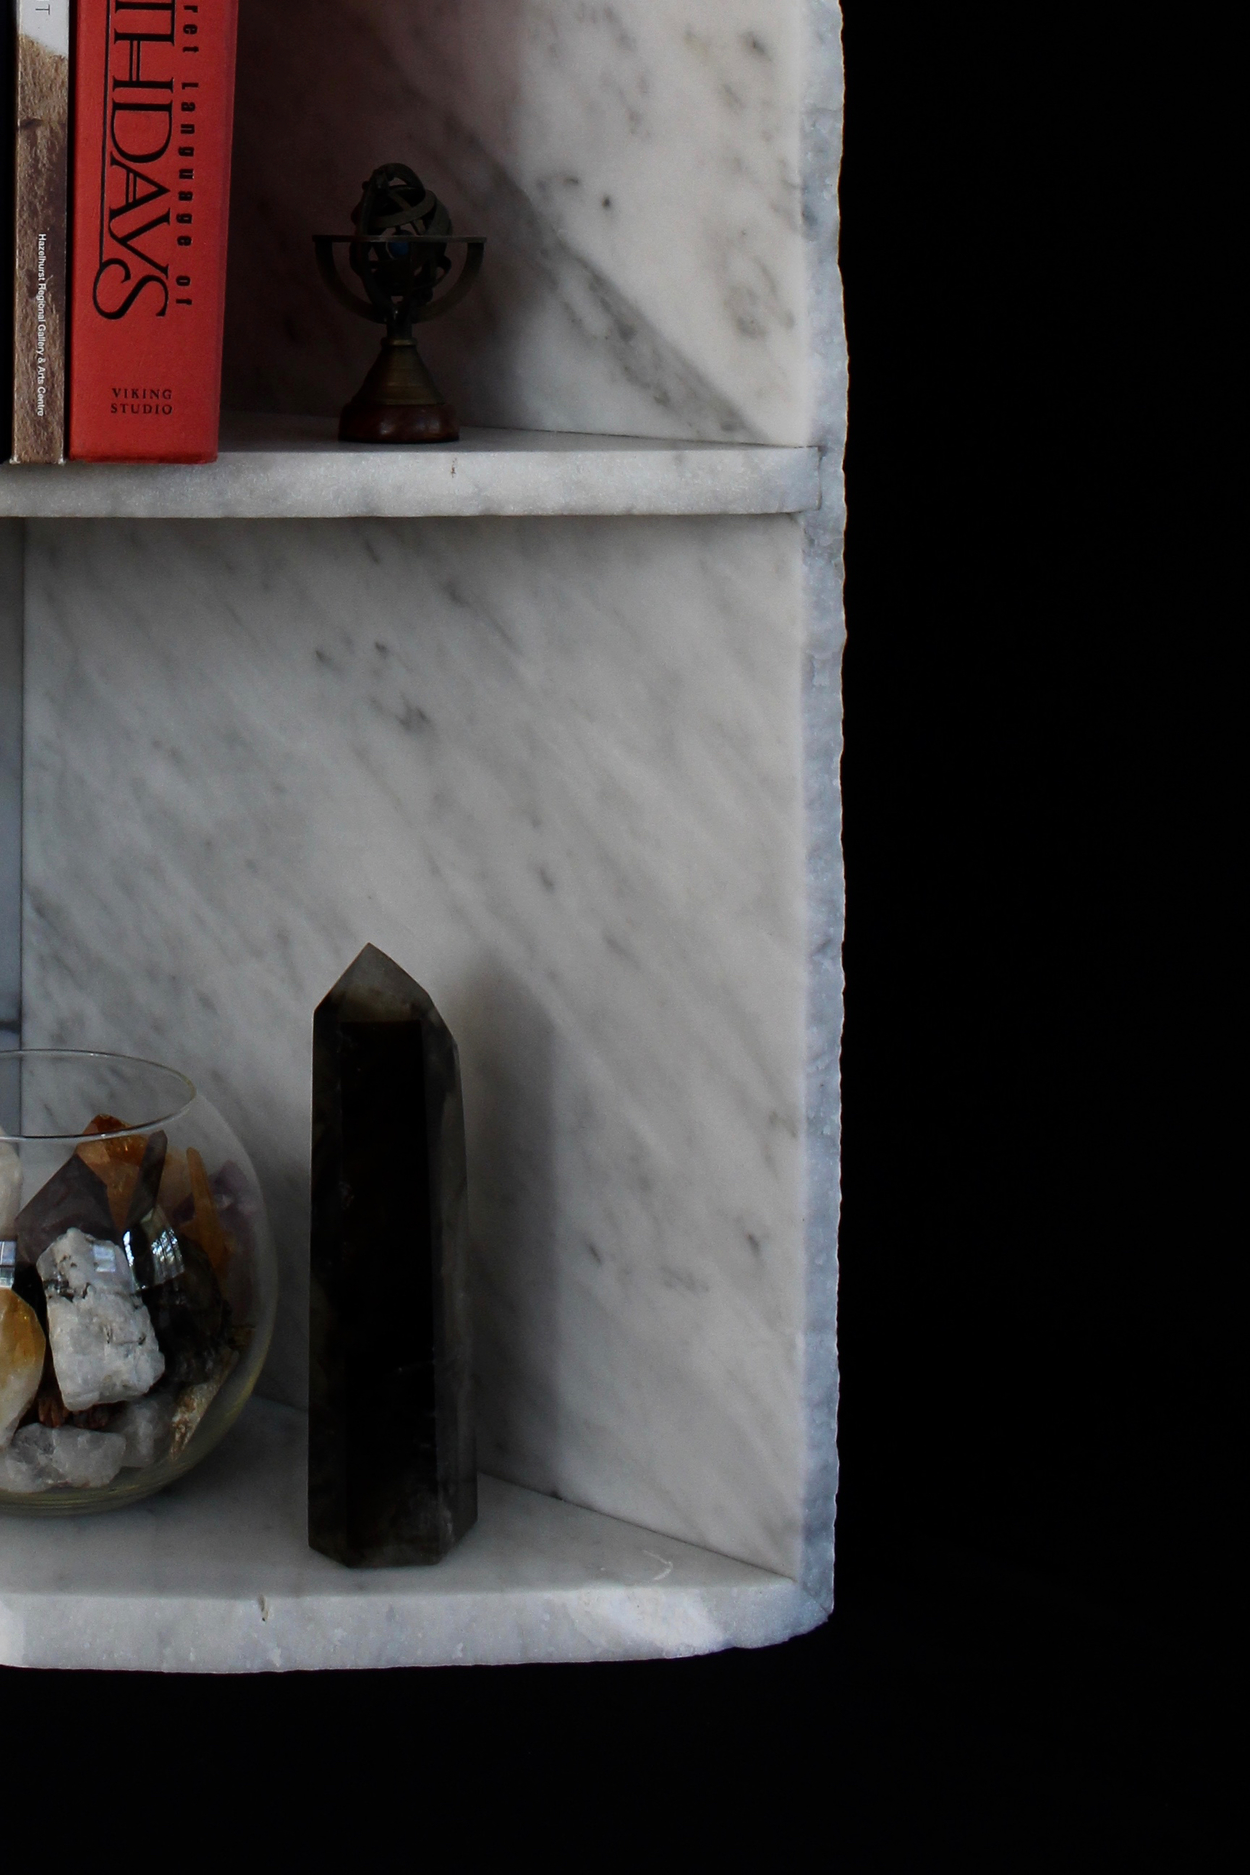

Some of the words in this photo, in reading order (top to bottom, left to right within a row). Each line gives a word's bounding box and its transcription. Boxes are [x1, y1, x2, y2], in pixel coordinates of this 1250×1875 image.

[175, 81, 200, 248] Language
[37, 233, 47, 281] Hazelhurst
[36, 283, 47, 322] Regional
[176, 275, 193, 306] of
[36, 324, 47, 356] Gallery
[37, 365, 46, 385] Arts
[110, 401, 174, 415] STUDIO
[111, 387, 174, 401] VIKING
